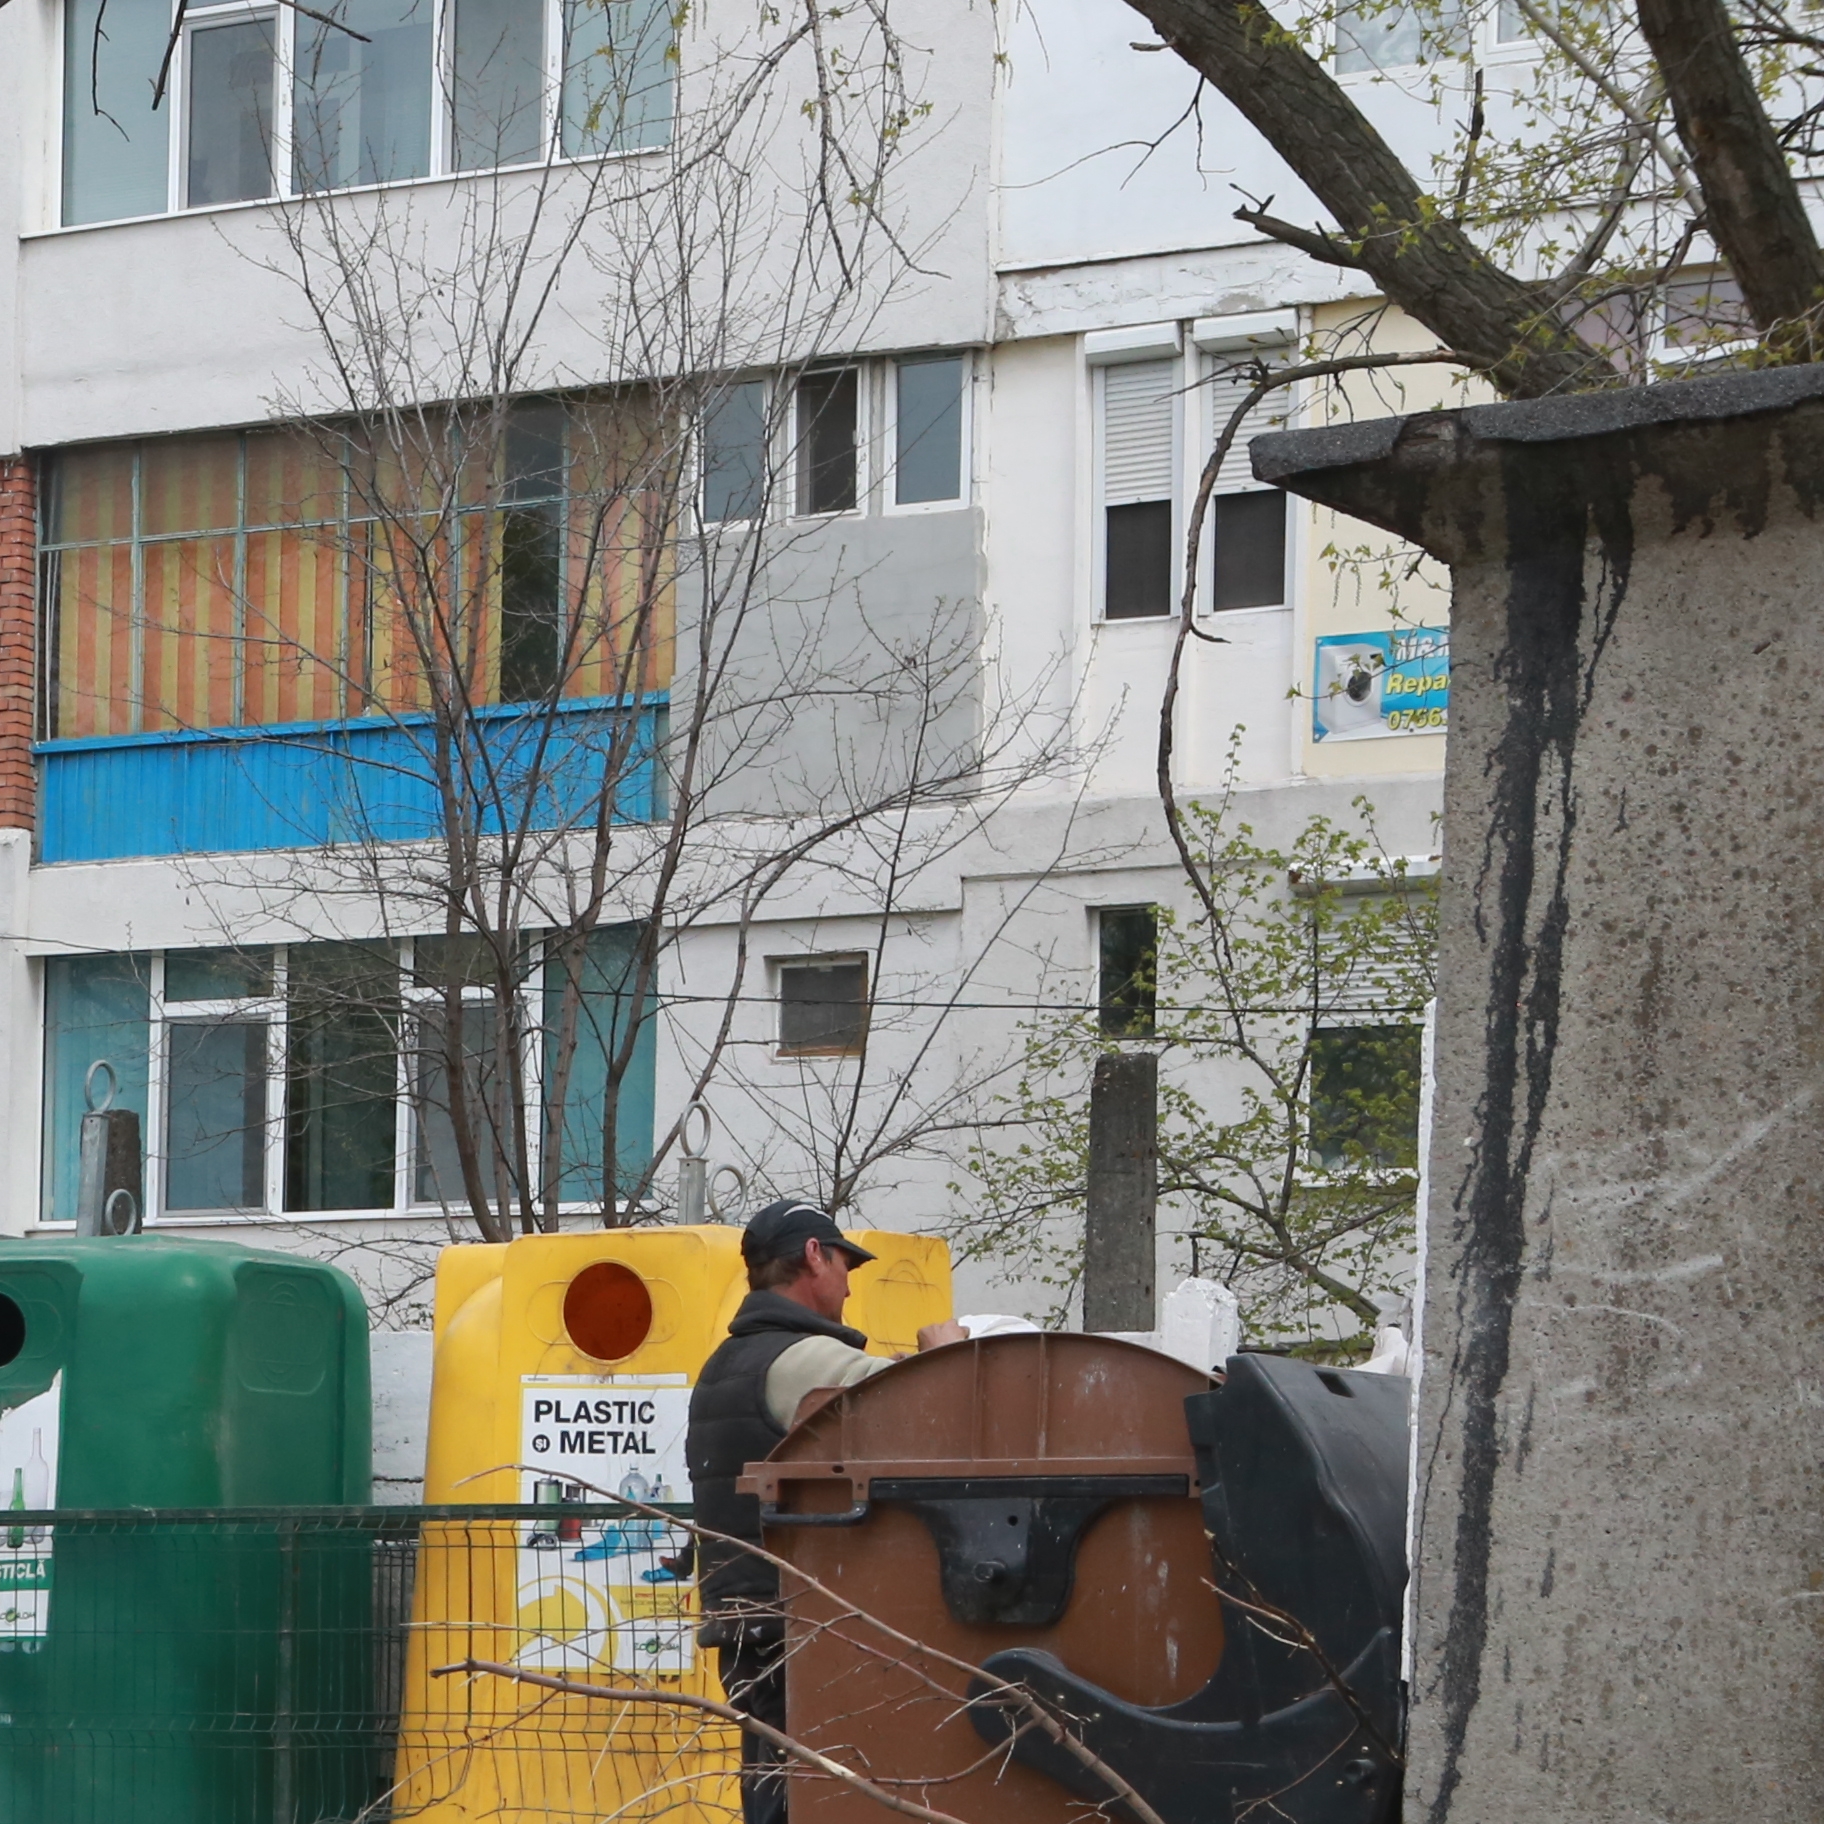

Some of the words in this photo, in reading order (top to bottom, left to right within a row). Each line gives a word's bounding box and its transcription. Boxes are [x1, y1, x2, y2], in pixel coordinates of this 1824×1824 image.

[1385, 673, 1450, 697] Repa
[534, 1399, 656, 1425] PLASTIC
[559, 1430, 657, 1455] METAL
